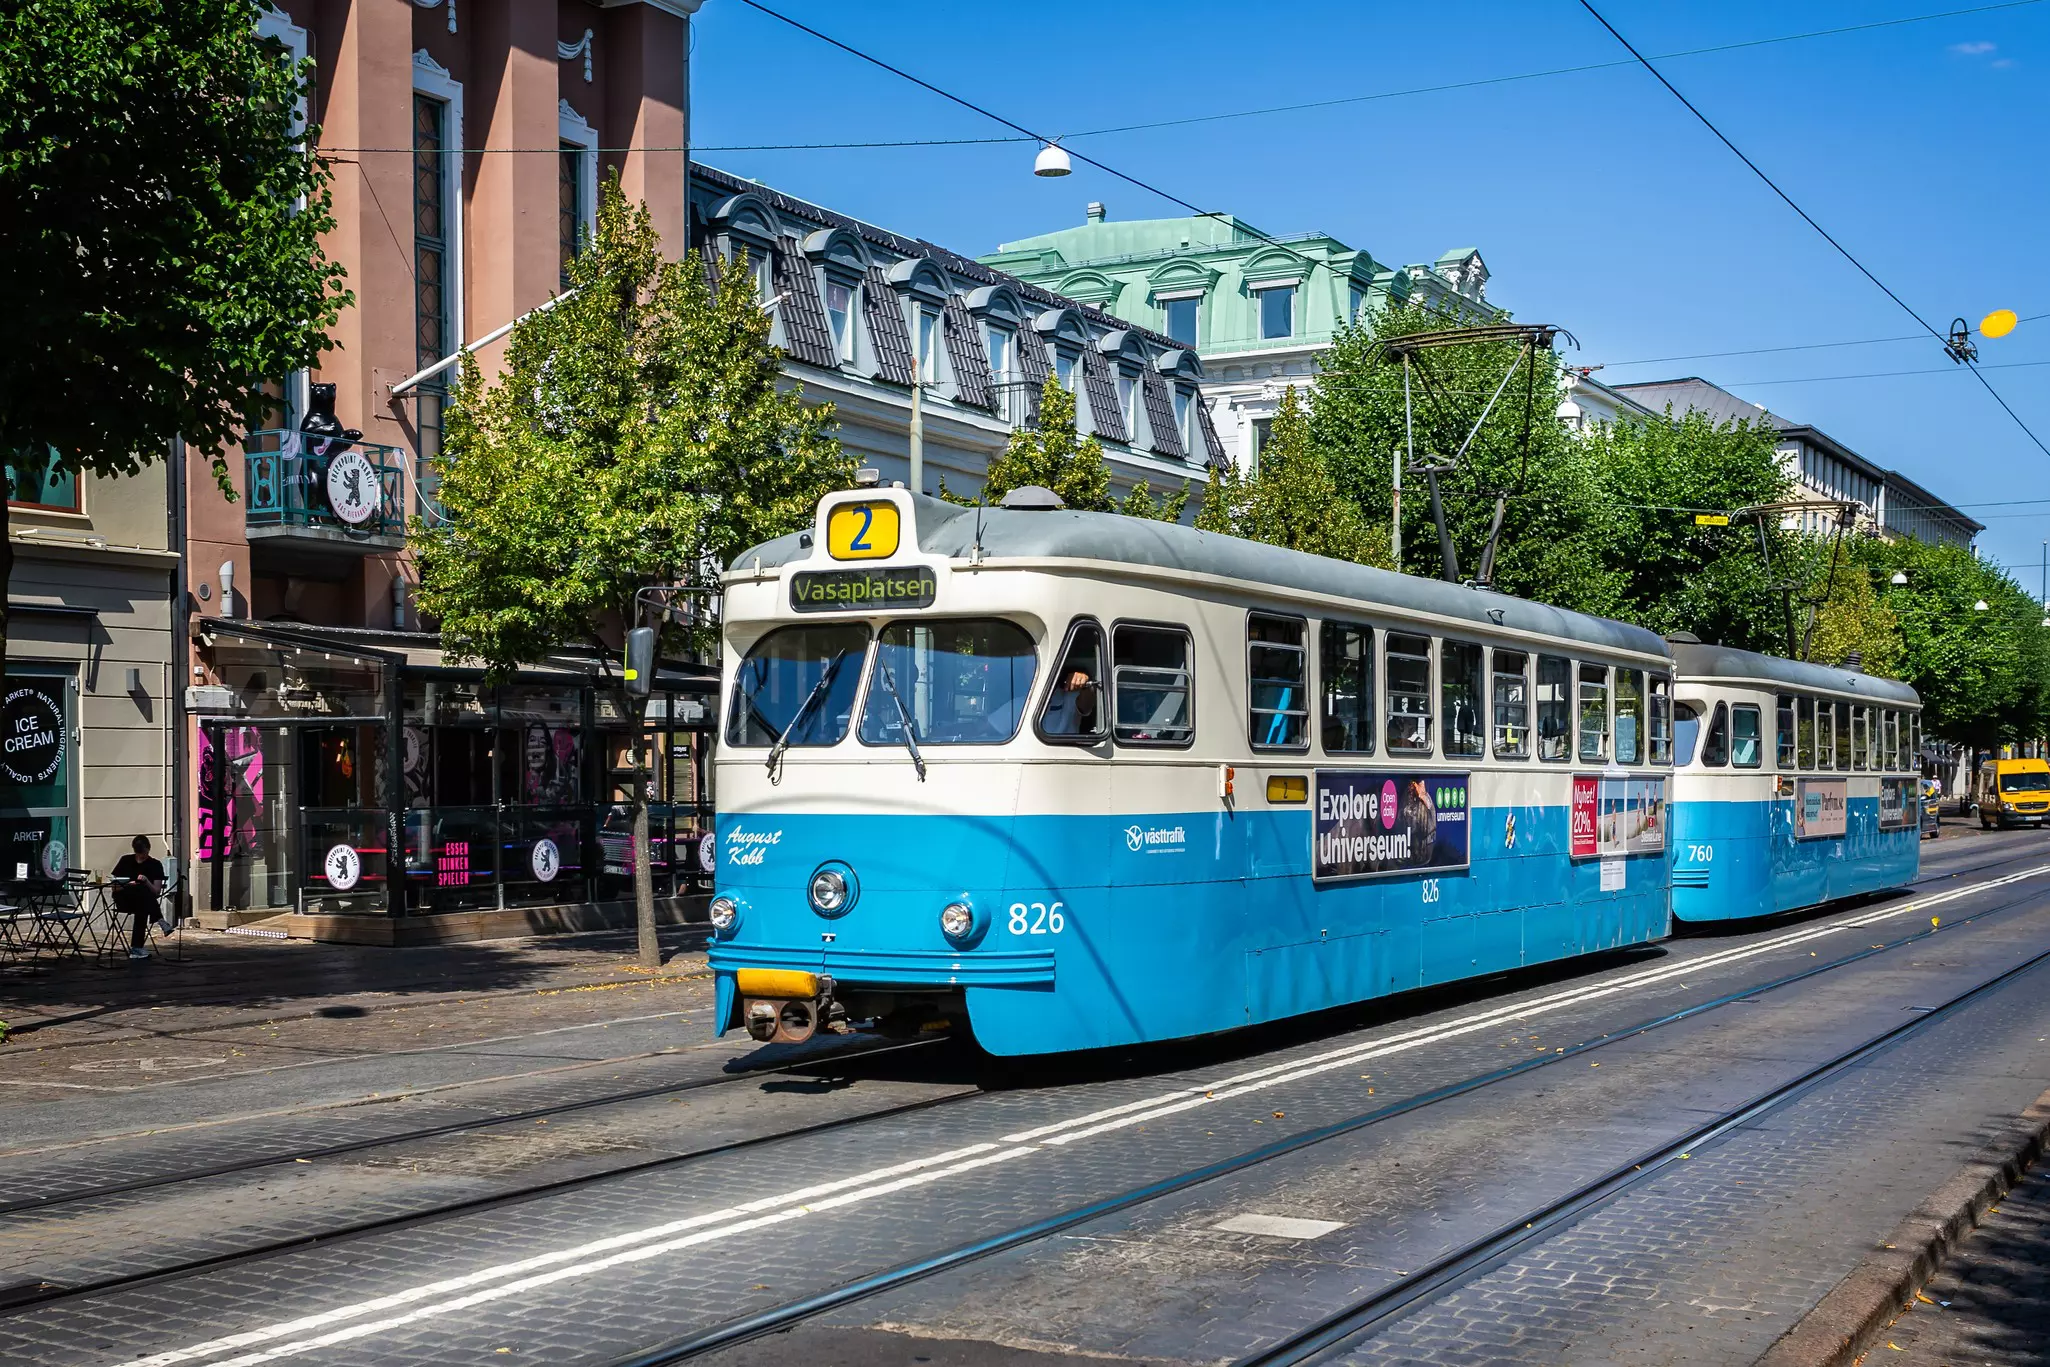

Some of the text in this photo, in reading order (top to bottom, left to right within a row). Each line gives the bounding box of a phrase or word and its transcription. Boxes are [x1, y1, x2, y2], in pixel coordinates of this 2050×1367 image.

[850, 506, 873, 551] 2
[795, 576, 935, 603] Vasaplatsen
[37, 691, 64, 726] NATURAL
[15, 715, 39, 733] ICE
[5, 730, 54, 753] CREAM
[37, 726, 66, 781] INGREDIENTS
[1283, 781, 1288, 799] 2
[1382, 793, 1396, 804] Open
[1574, 784, 1596, 809] Nyhet!
[1320, 785, 1378, 827] Explore
[1382, 804, 1395, 818] daily
[1436, 811, 1466, 822] universeum
[13, 830, 45, 842] ARKET
[725, 825, 783, 849] August
[1144, 826, 1186, 845] västtrafik
[1319, 826, 1412, 865] Universeum!
[446, 842, 469, 856] ESSEN
[728, 846, 767, 866] Kobb
[1687, 844, 1713, 862] 760
[438, 871, 469, 886] SPIELEN
[1422, 878, 1440, 904] 826
[1008, 901, 1065, 936] 826
